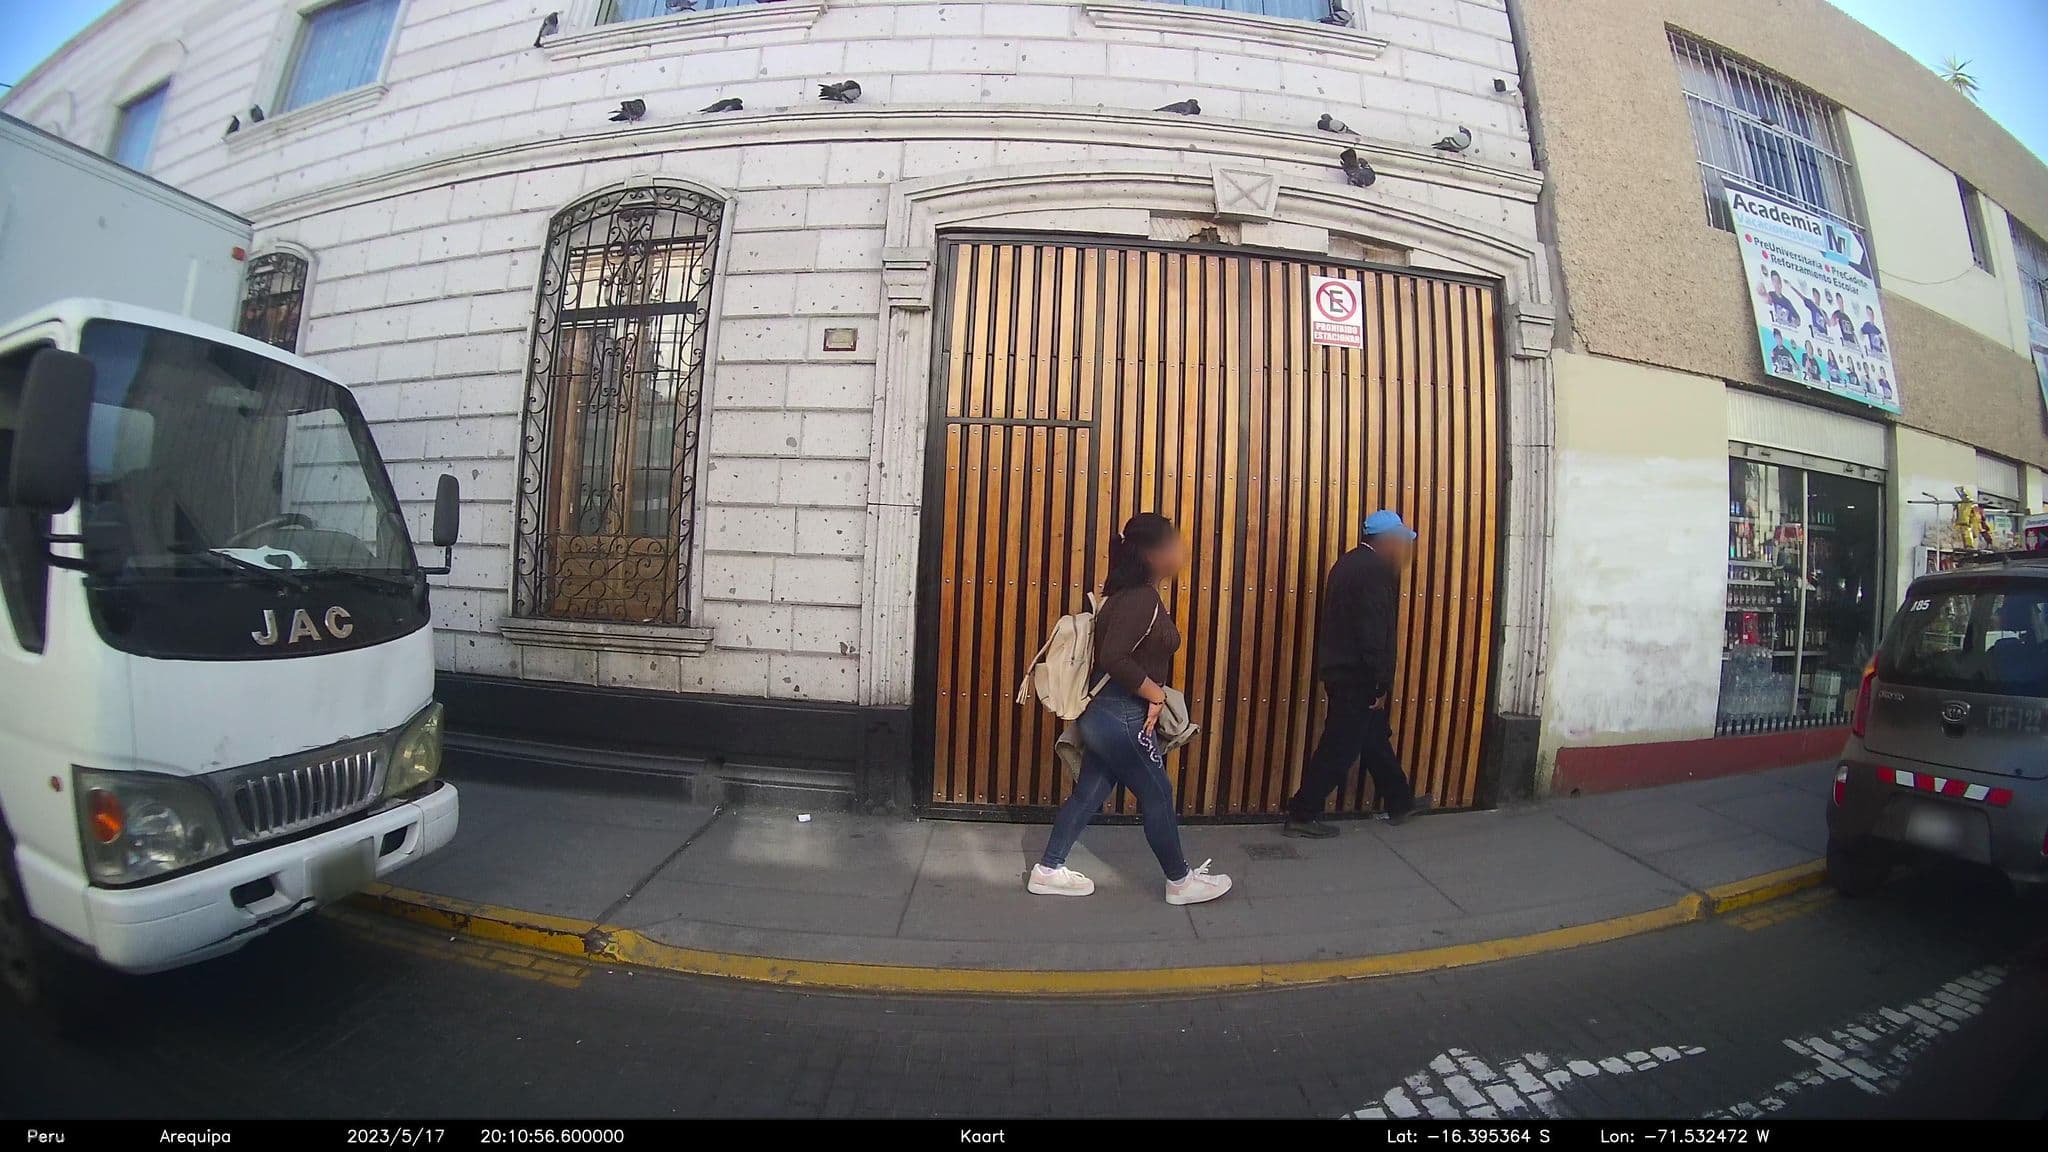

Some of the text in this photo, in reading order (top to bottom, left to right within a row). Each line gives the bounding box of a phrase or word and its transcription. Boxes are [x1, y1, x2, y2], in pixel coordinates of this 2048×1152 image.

[1733, 194, 1822, 236] Academia
[1329, 289, 1344, 313] E
[1314, 332, 1360, 343] ESTACIONAR
[1315, 322, 1358, 335] PROHIBIDO
[250, 605, 355, 647] JAC
